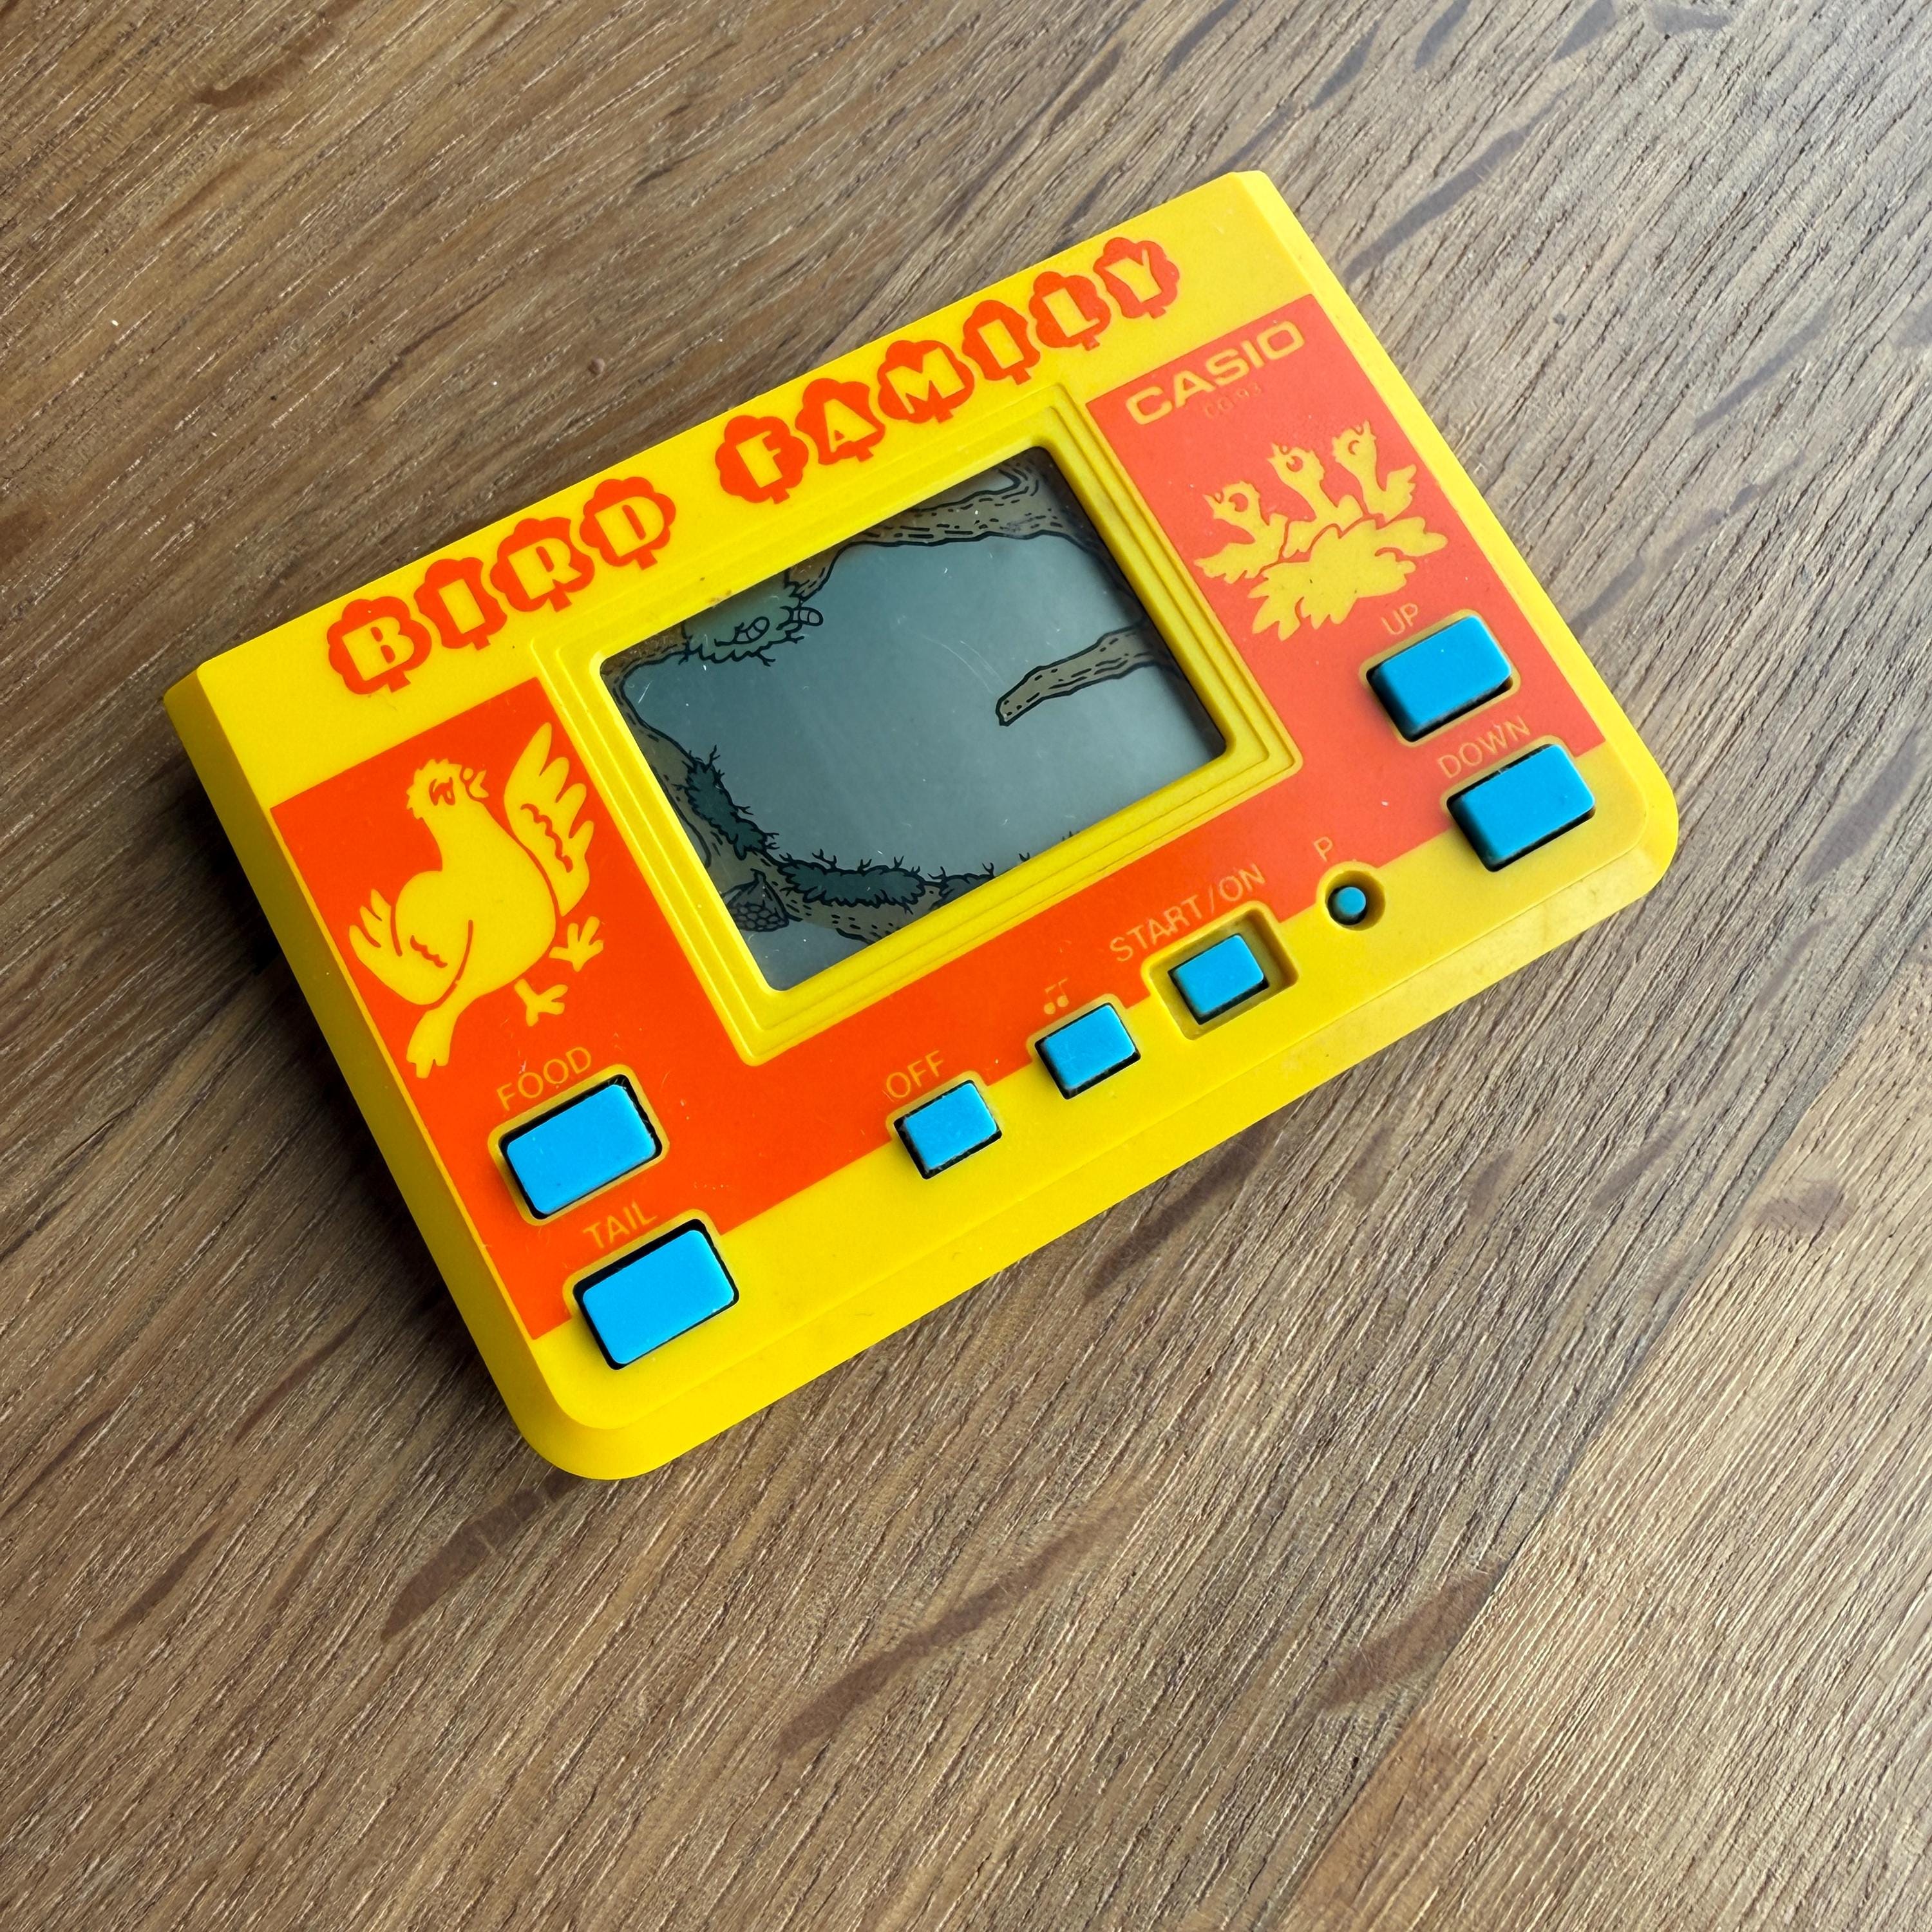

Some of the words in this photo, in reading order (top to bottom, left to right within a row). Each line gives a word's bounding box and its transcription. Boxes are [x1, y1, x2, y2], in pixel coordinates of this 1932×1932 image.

[1125, 321, 1305, 425] CASIO
[341, 495, 665, 682] BIRD
[735, 249, 1162, 488] FAMILY
[1381, 602, 1419, 635] UP
[1437, 715, 1531, 778] DOWN
[1313, 836, 1334, 862] P
[1109, 862, 1266, 962] START/ON
[497, 1046, 592, 1111] FOOD
[886, 1049, 944, 1099] OFF
[583, 1200, 658, 1249] TAIL
